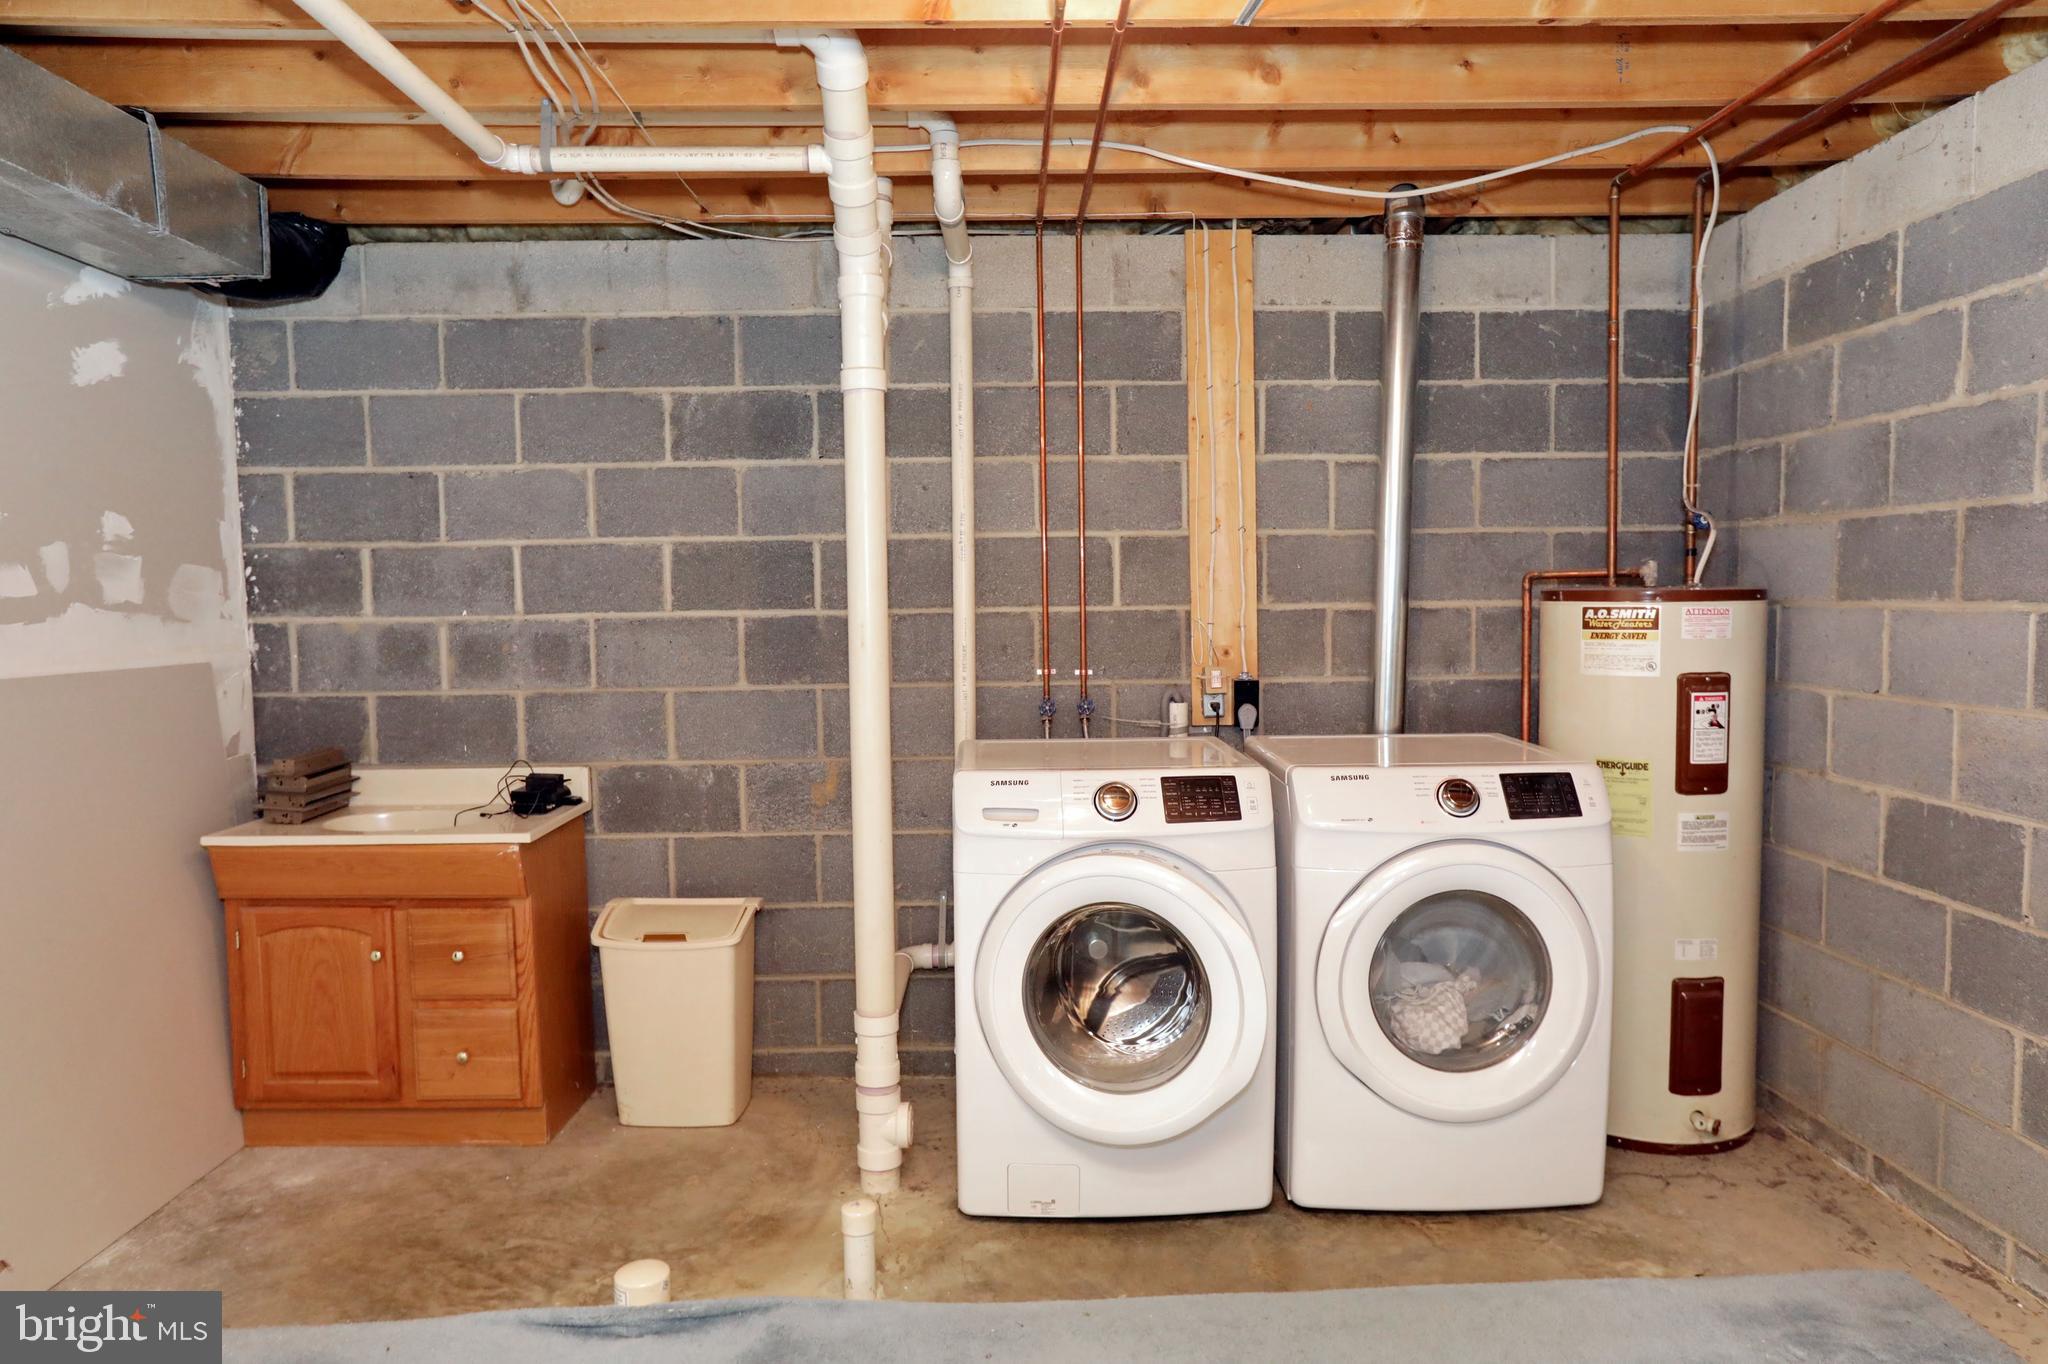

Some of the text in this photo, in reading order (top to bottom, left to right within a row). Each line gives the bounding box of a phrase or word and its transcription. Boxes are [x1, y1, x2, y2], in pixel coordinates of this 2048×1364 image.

[1588, 618, 1653, 629] Water Heaters
[1590, 632, 1648, 640] ENERGY SAVER
[990, 779, 1029, 787] SAMSUNG
